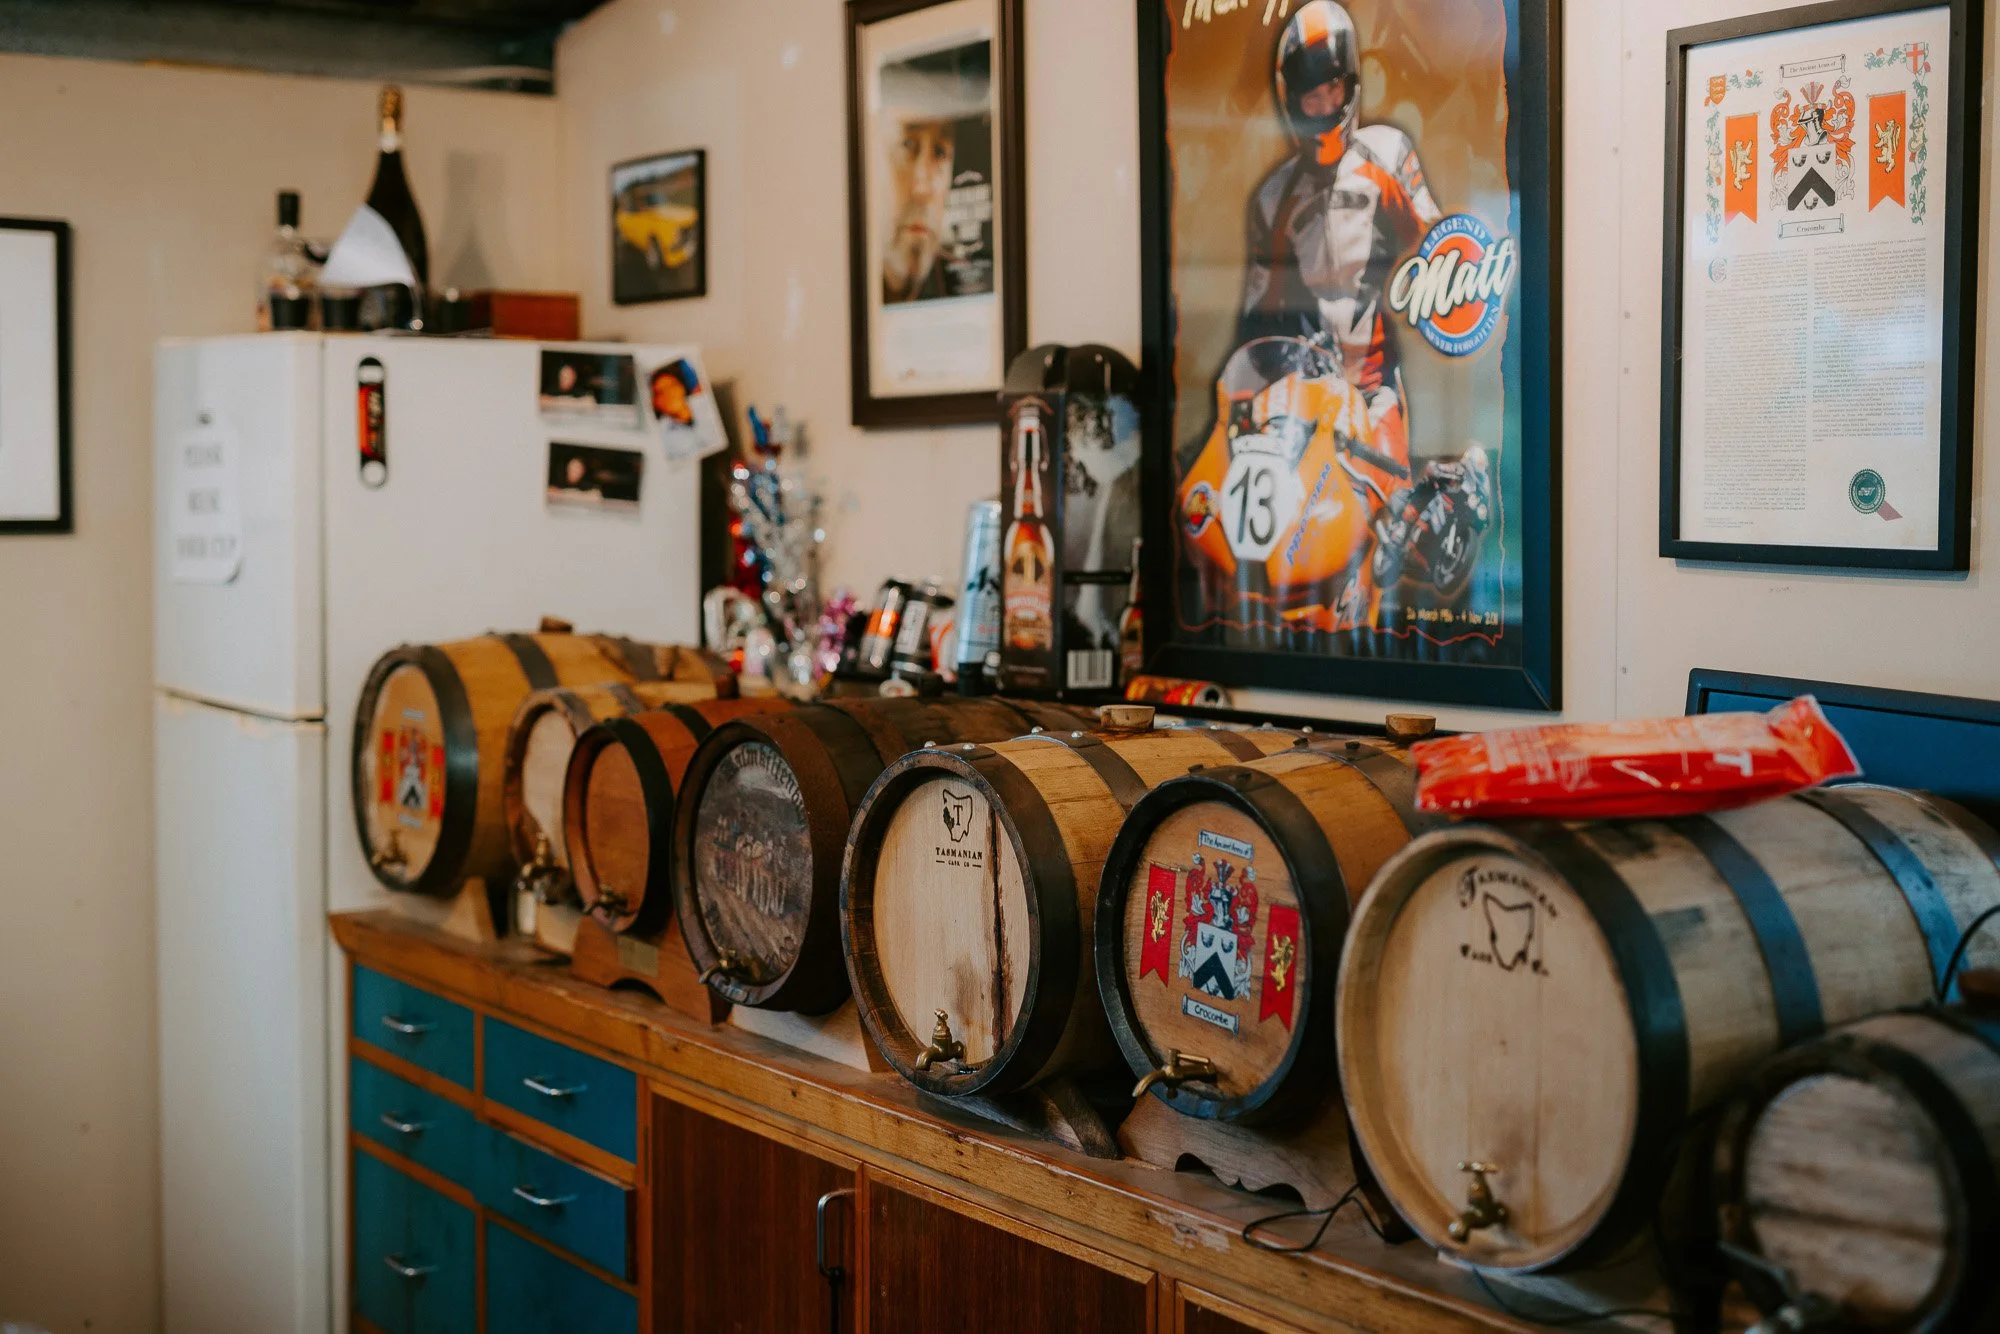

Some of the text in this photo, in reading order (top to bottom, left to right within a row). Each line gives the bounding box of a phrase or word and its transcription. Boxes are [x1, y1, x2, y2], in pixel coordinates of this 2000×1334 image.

[1423, 217, 1487, 252] LEGEND
[1389, 237, 1517, 326] Matt
[1229, 466, 1277, 546] 13
[953, 805, 963, 826] T
[1202, 832, 1213, 844] The
[935, 847, 983, 861] TASMANIAN
